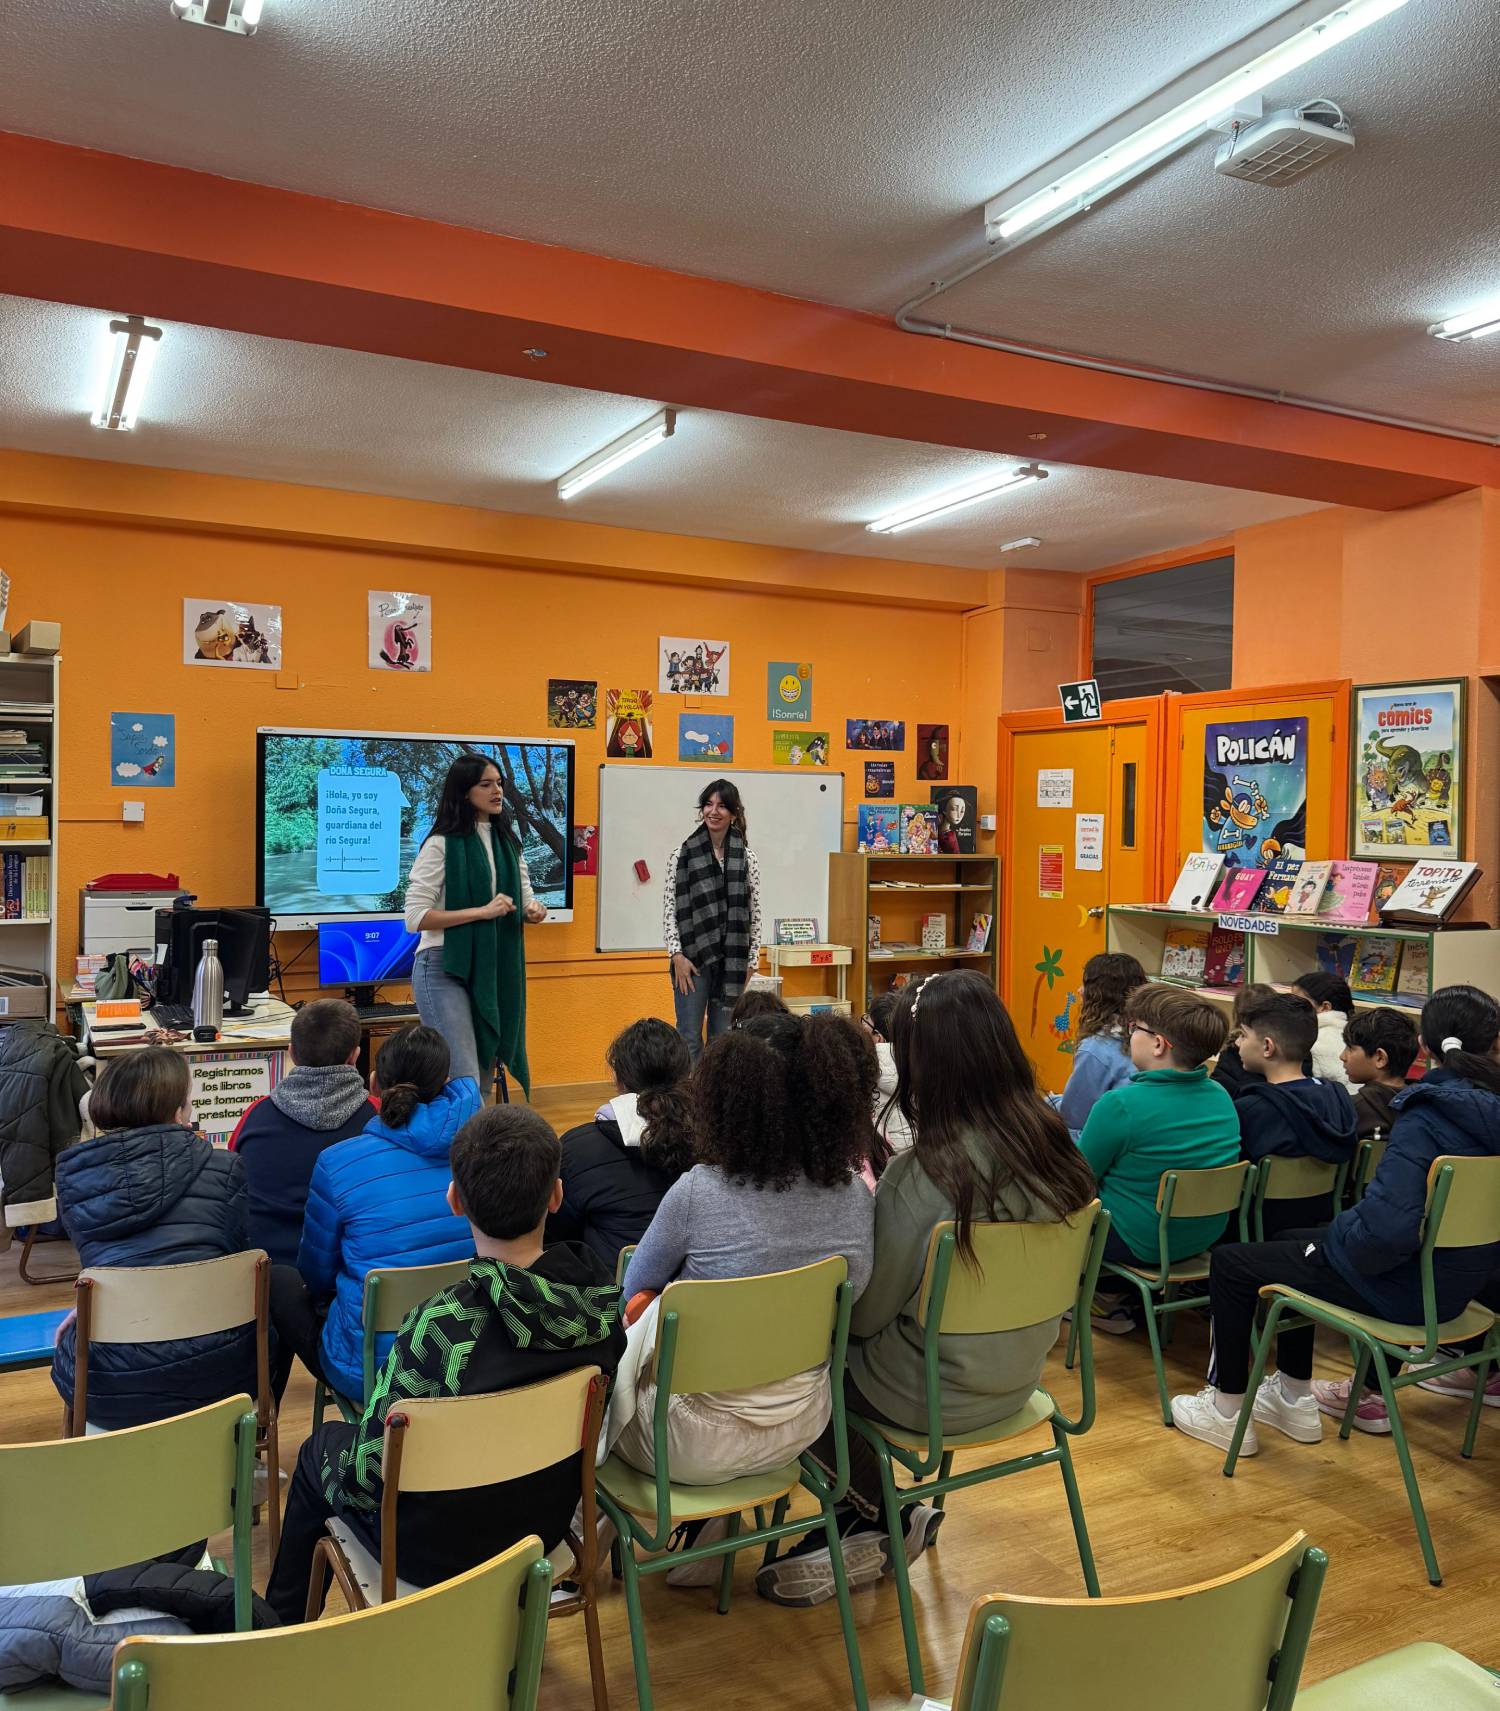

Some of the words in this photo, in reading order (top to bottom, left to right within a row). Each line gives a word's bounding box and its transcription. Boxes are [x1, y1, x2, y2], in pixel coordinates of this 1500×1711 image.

[1377, 704, 1433, 727] cómics
[1216, 728, 1297, 764] POLICÁN
[330, 764, 352, 776] DOÑA
[354, 767, 387, 777] SEGURA
[326, 790, 350, 801] ¡Hola,
[352, 792, 362, 801] yo
[363, 792, 378, 802] soy
[326, 805, 347, 815] Doña
[348, 805, 380, 817] Segura,
[325, 821, 368, 832] guardiana
[369, 821, 382, 830] del
[339, 836, 370, 846] Segura!
[1274, 860, 1284, 870] El
[1286, 863, 1300, 873] pez
[1234, 872, 1256, 881] GUAY
[1219, 915, 1278, 933] NOVEDADES
[364, 931, 380, 939] 9:07
[194, 1067, 264, 1079] Registramos
[202, 1082, 218, 1092] los
[221, 1081, 252, 1090] libros
[191, 1098, 212, 1108] que
[198, 1108, 246, 1121] prestad
